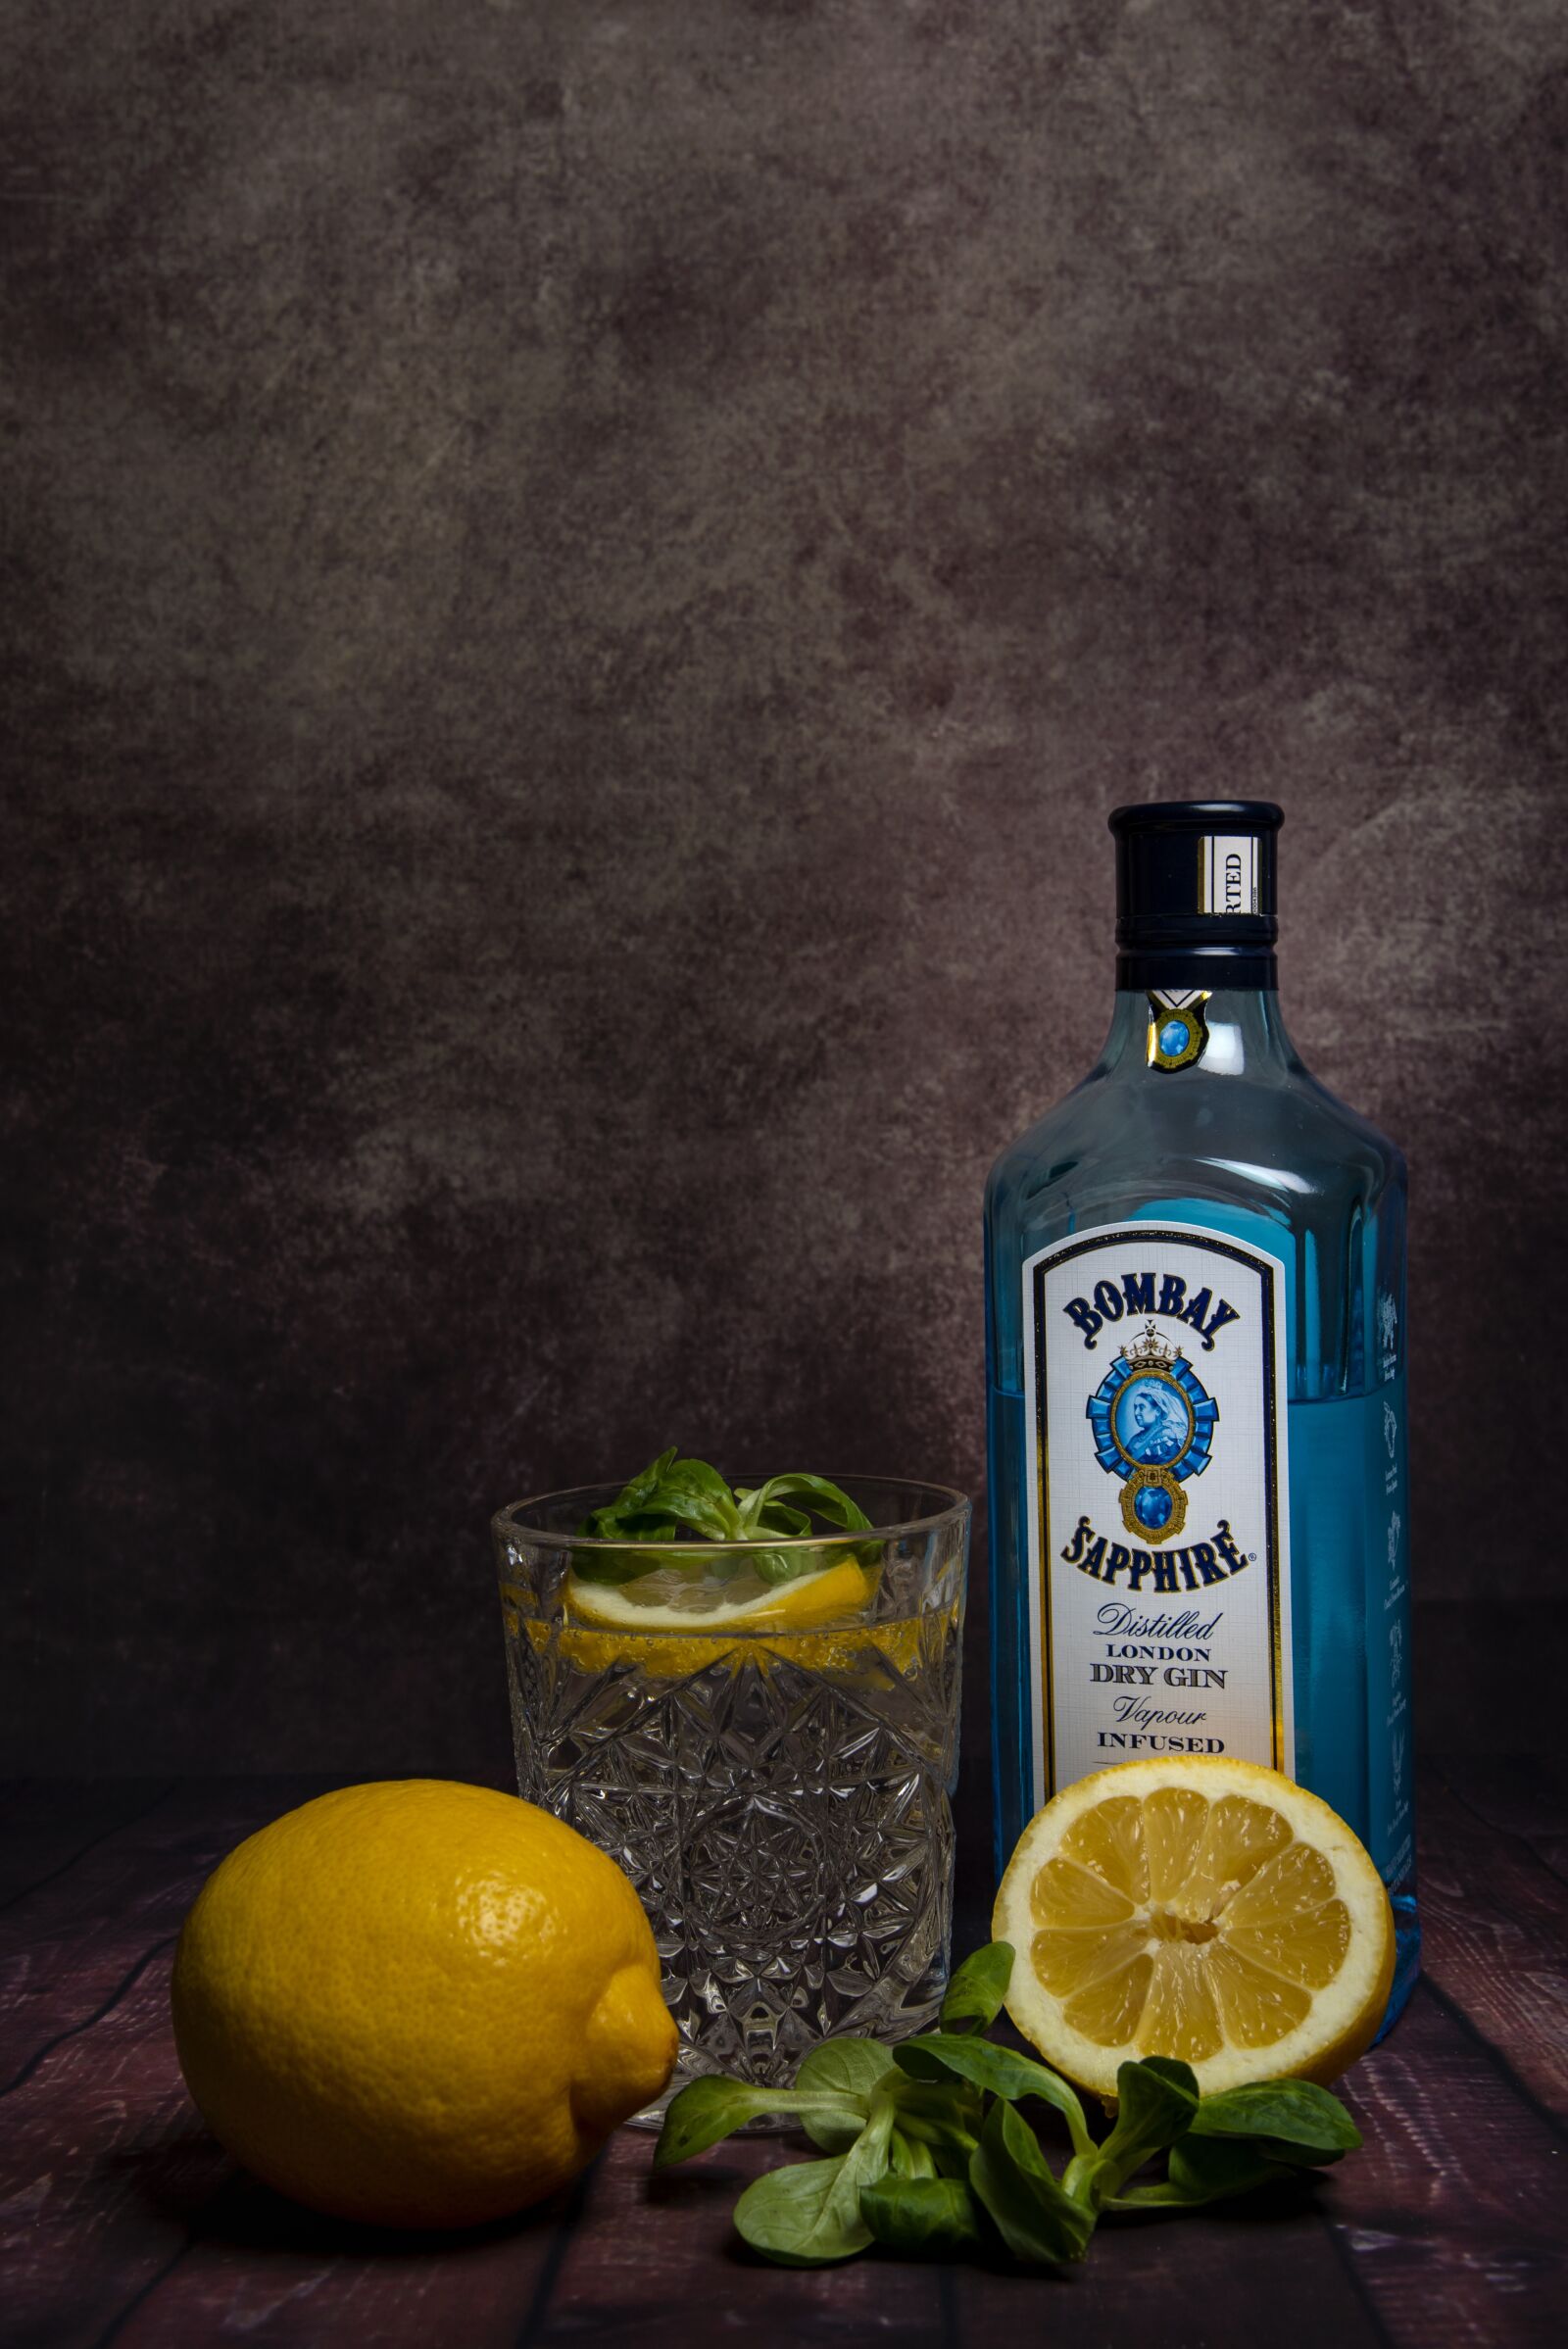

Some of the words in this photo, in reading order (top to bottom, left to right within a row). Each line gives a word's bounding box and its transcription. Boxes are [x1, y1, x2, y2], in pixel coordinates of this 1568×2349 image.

[1063, 1272, 1240, 1351] BOMBAY
[1093, 1602, 1223, 1639] Distilled
[1105, 1643, 1212, 1662] LONDON
[1090, 1663, 1158, 1685] DRY
[1163, 1667, 1228, 1689] GIN
[1112, 1695, 1206, 1731] Vapour
[1097, 1732, 1225, 1754] INFUSED
